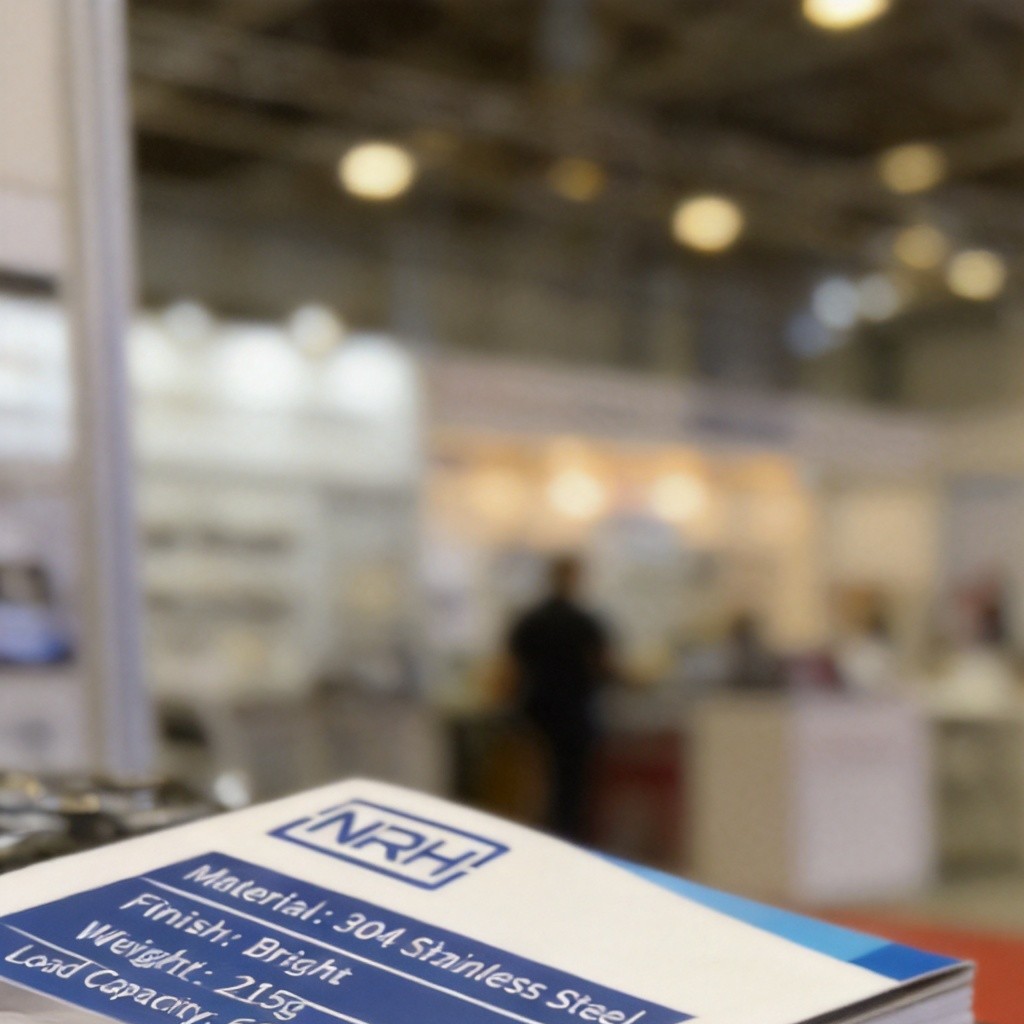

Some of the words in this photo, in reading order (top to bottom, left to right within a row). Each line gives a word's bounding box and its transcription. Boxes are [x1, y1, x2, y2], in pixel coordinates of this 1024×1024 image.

[306, 811, 478, 877] NRH
[5, 944, 91, 980] Load
[76, 920, 213, 985] Weight:
[213, 975, 307, 1021] 215g
[119, 893, 242, 947] Finish:
[242, 936, 353, 986] Bright
[183, 864, 333, 925] Material:
[333, 913, 406, 949] 304
[400, 936, 548, 1000] Stainless
